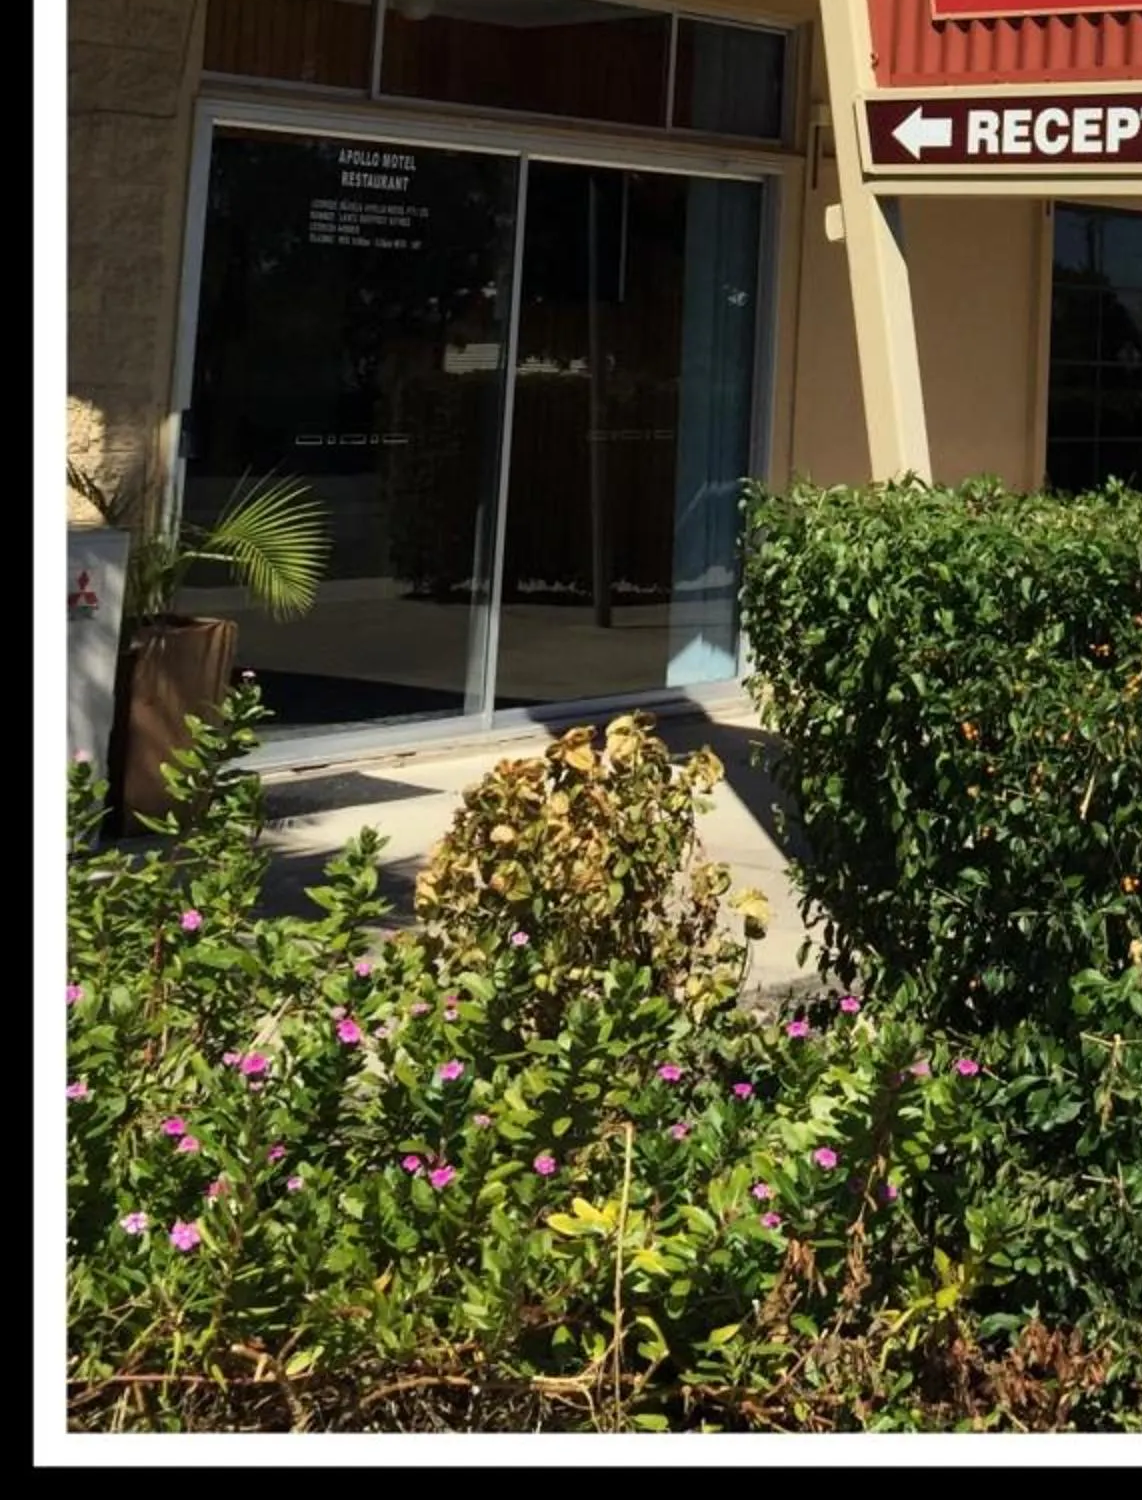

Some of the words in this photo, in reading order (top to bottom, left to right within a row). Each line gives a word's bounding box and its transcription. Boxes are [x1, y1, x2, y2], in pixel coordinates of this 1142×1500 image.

[339, 149, 379, 167] APOLLO
[382, 153, 416, 171] MOTEL
[341, 171, 409, 191] RESTAURANT
